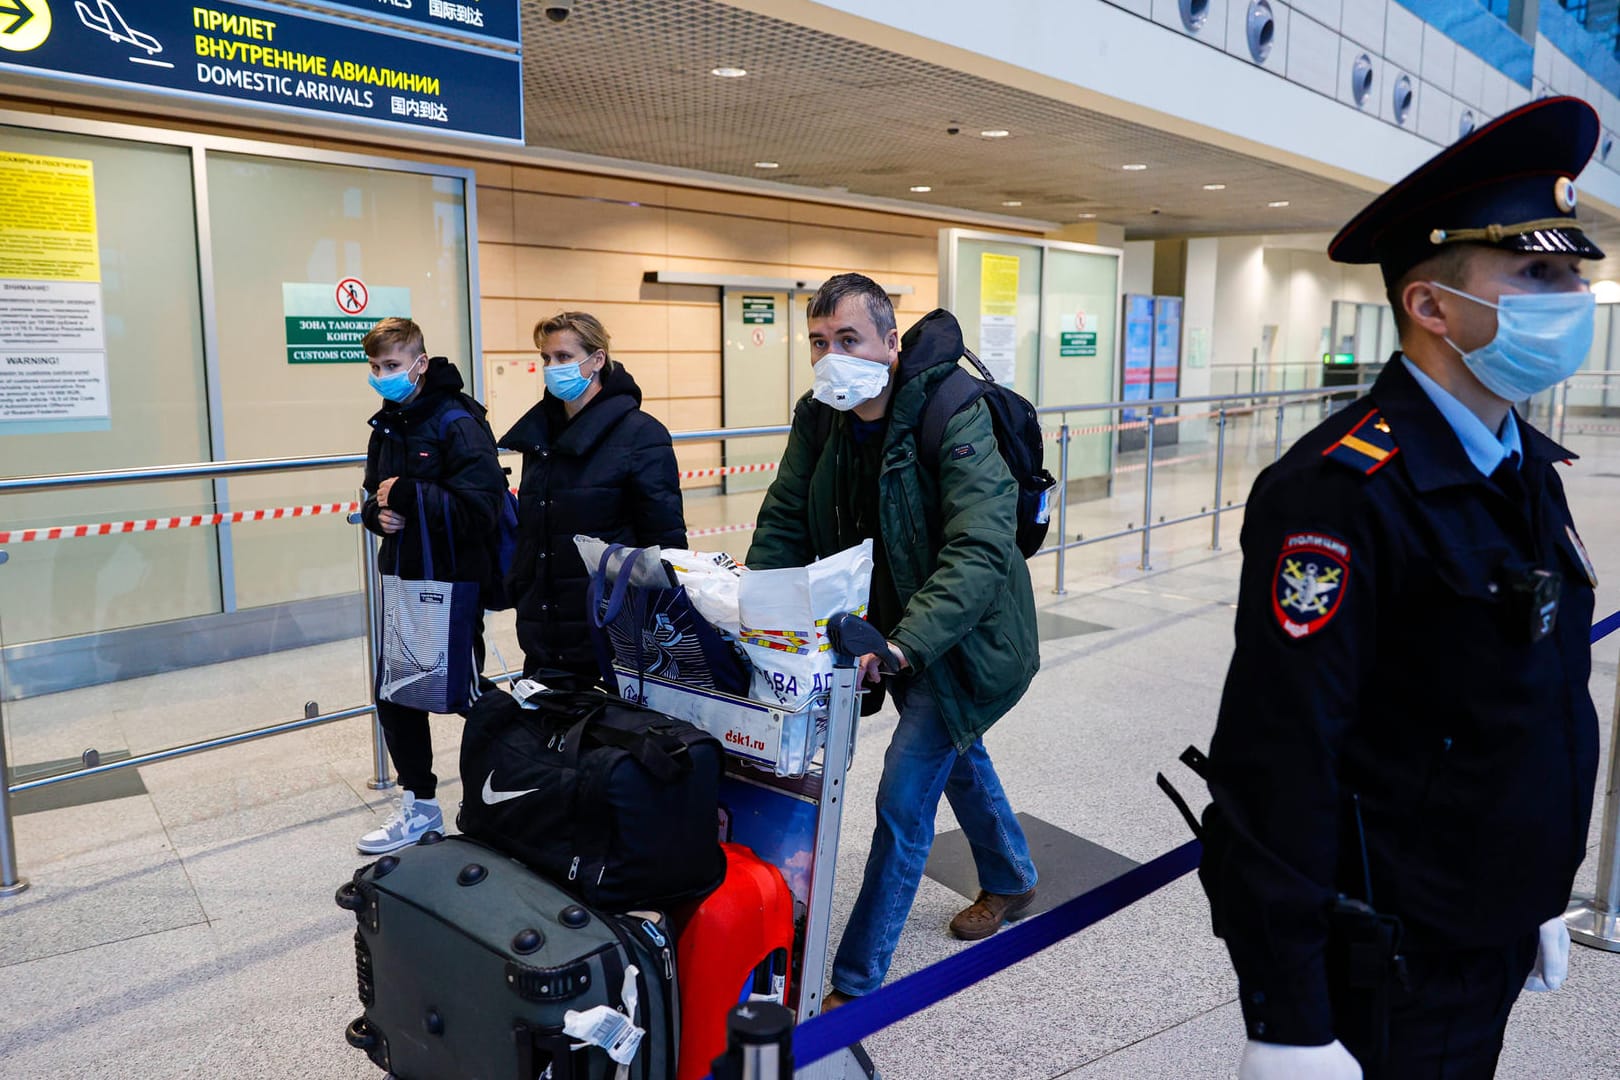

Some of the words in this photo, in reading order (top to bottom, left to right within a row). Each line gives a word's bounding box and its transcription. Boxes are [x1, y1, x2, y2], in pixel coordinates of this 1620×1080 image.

[193, 7, 277, 41] ПРИЛЕТ
[429, 0, 484, 27] 国际到达
[195, 34, 327, 76] ВНУТРЕННИЕ
[331, 59, 440, 96] АВИАЛИНИИ
[197, 63, 293, 96] DOMESTIC
[295, 79, 374, 108] ARRIVALS
[391, 95, 448, 122] 国内到达
[299, 321, 326, 330] ЗОНА
[327, 332, 368, 341] КОНТРО
[6, 356, 60, 365] WARNING!
[293, 351, 339, 360] CUSTOMS
[340, 350, 369, 359] CONT
[725, 729, 766, 751] dsk1.ru
